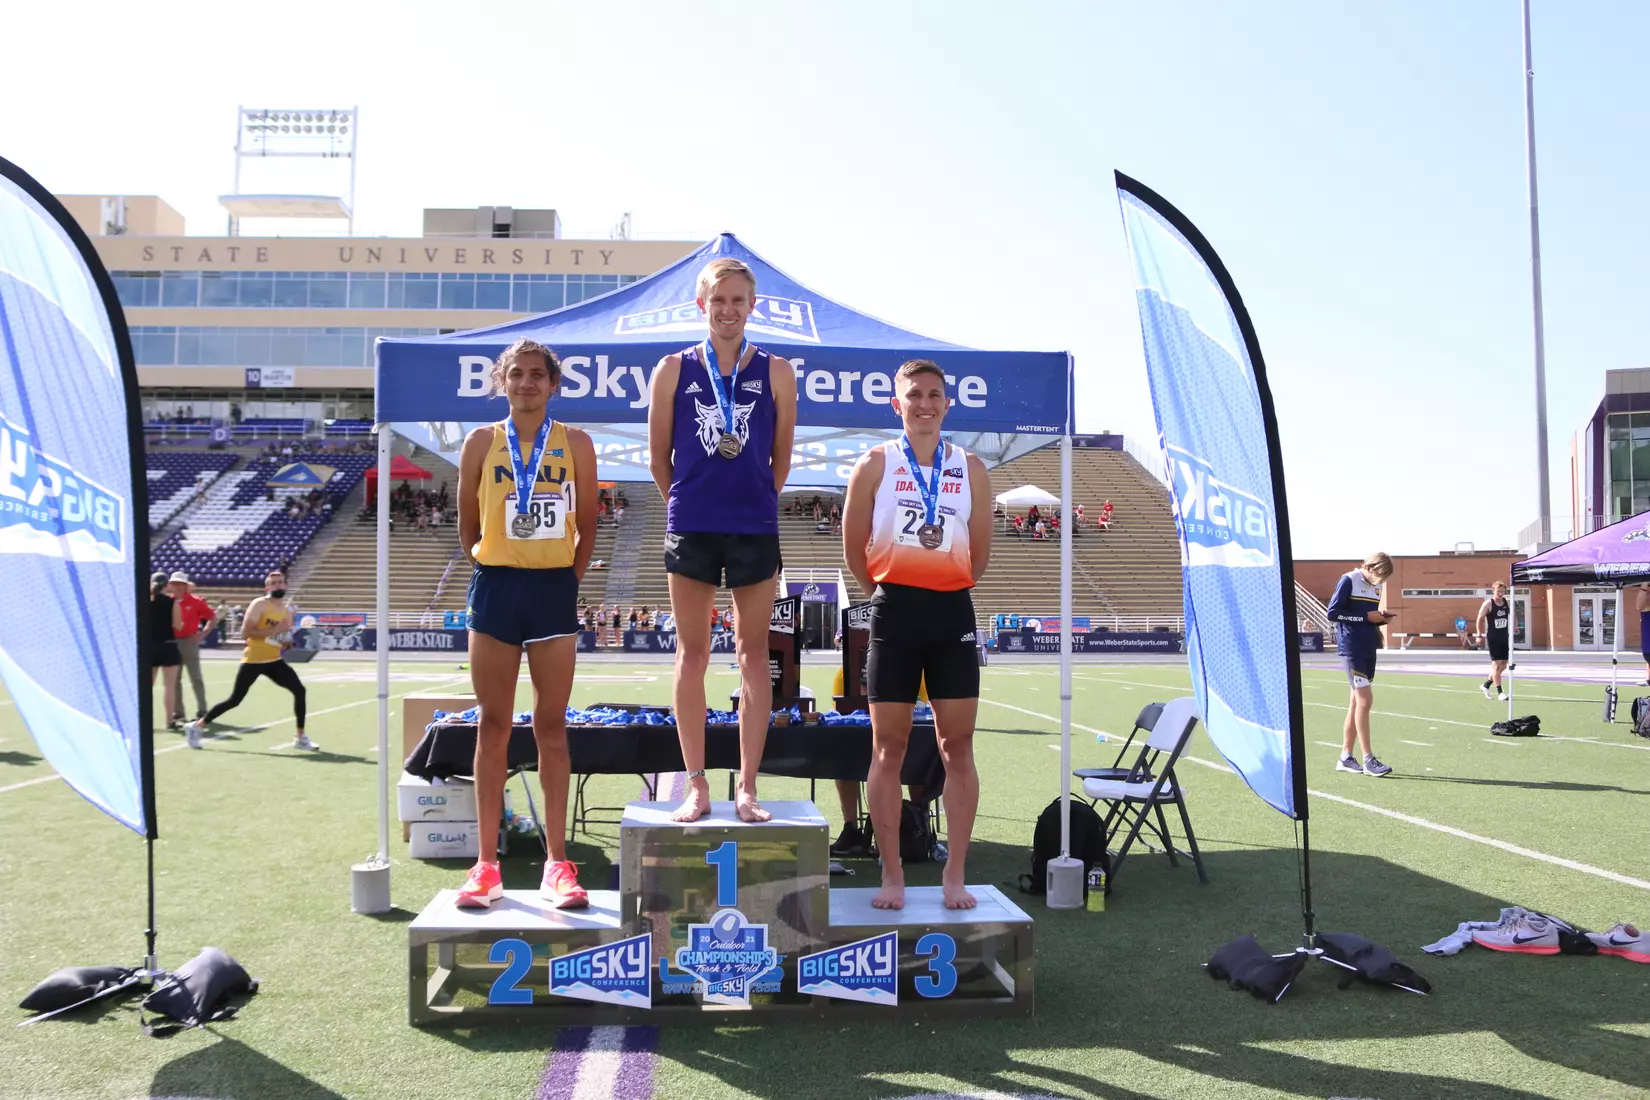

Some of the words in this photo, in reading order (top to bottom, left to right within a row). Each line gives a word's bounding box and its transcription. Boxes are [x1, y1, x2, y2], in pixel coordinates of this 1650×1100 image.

[142, 246, 269, 263] STATE
[338, 246, 615, 266] UNIVERSITY
[248, 371, 260, 382] 10
[215, 429, 225, 440] D
[1016, 425, 1060, 433] MASTERTENT
[494, 465, 567, 484] NU
[895, 481, 926, 492] IDA
[942, 483, 962, 494] ATE
[565, 484, 572, 511] 1
[515, 502, 556, 528] 85
[1032, 636, 1060, 644] WEBER
[1089, 639, 1169, 647] www.WeberStateSports.com
[705, 841, 737, 907] 1
[709, 940, 745, 950] Outdoor
[680, 951, 773, 966] CHAMPIONSHIPS
[914, 932, 958, 998] 3
[489, 938, 533, 1004] 2
[695, 964, 720, 973] Track
[722, 964, 732, 973] &
[734, 963, 761, 973] Field
